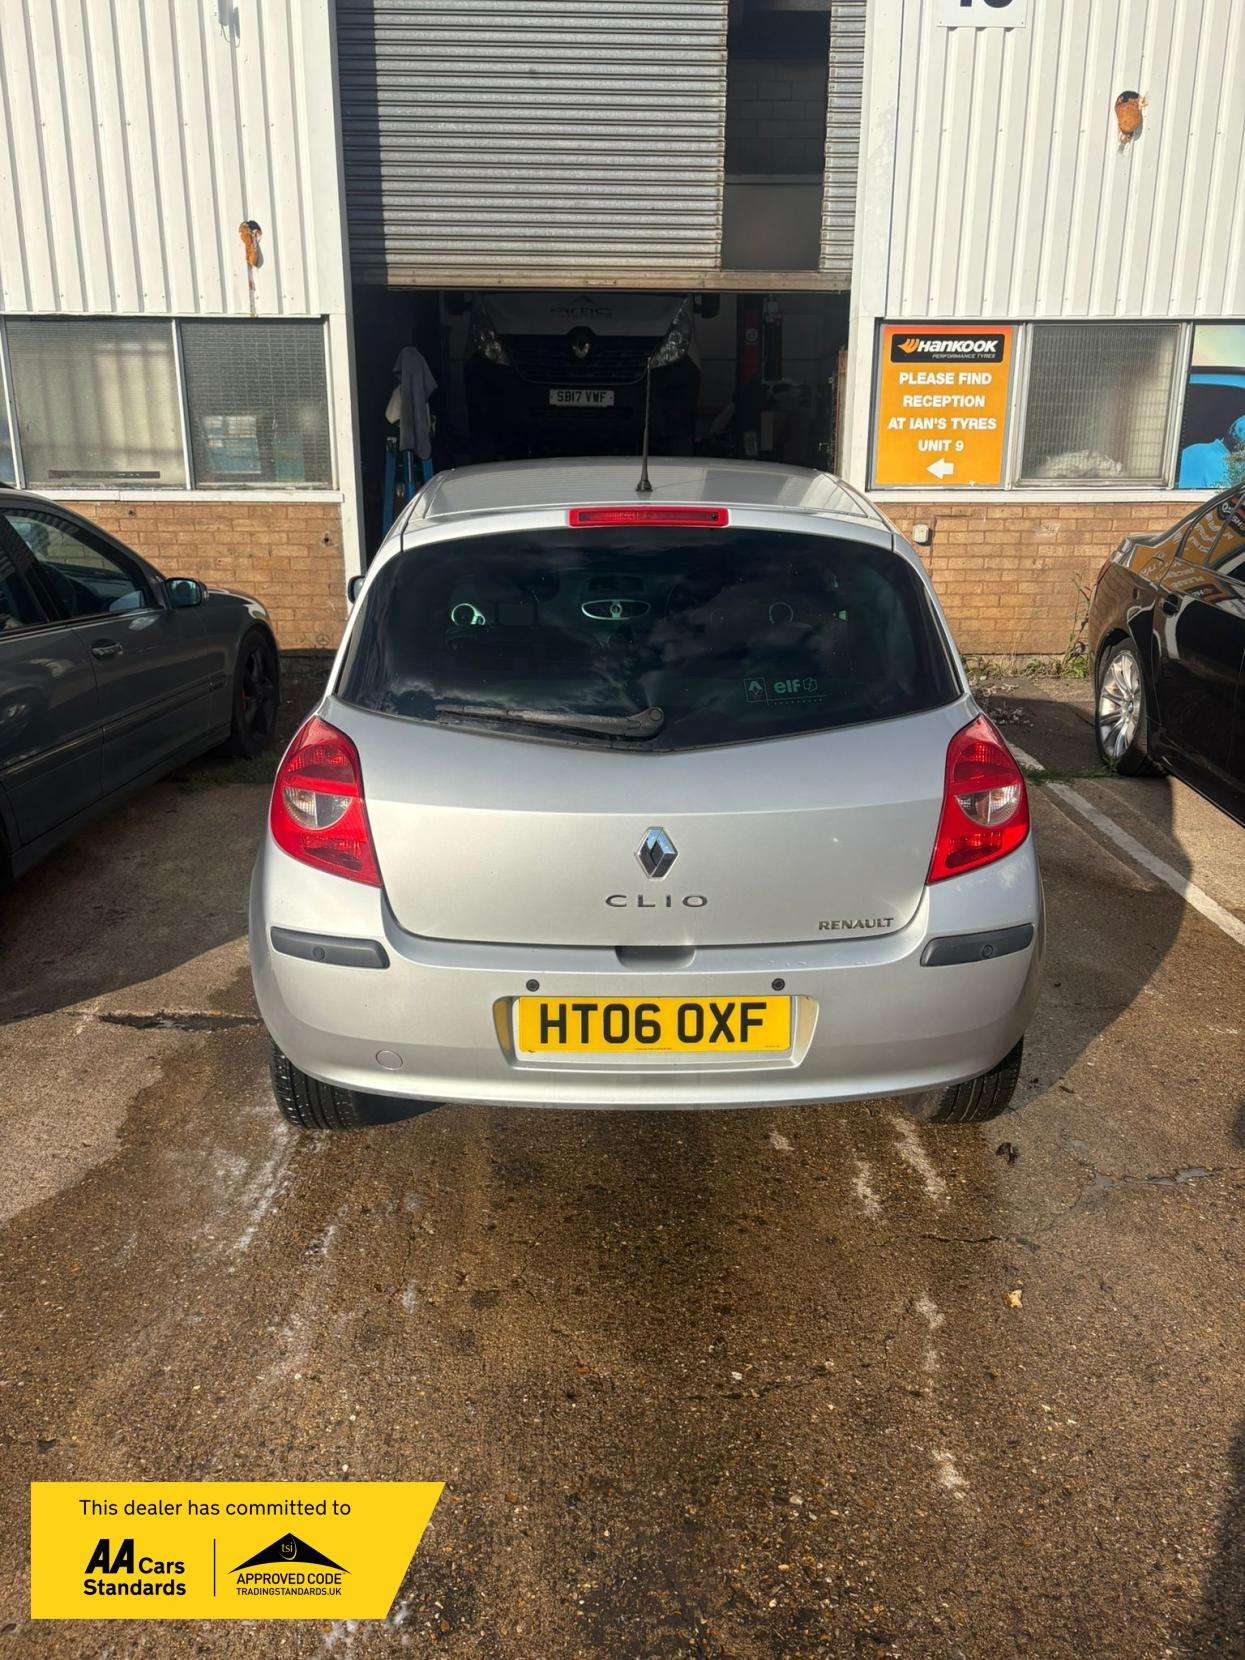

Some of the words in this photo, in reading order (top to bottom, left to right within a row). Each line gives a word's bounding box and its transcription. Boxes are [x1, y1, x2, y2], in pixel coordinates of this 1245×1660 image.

[899, 372, 954, 385] PLEASE
[959, 372, 992, 385] FIND
[557, 391, 582, 402] SB17
[585, 391, 607, 403] VWF
[903, 395, 985, 408] RECEPTION
[888, 418, 906, 429] AT
[909, 418, 947, 430] IAN'S
[951, 418, 997, 430] TYRES
[918, 440, 951, 451] UNIT
[955, 440, 964, 451] 9
[774, 679, 801, 693] elf
[605, 894, 708, 908] CLIO
[819, 918, 894, 930] RENAULT
[540, 1003, 661, 1044] HT06
[677, 1002, 767, 1043] OXF
